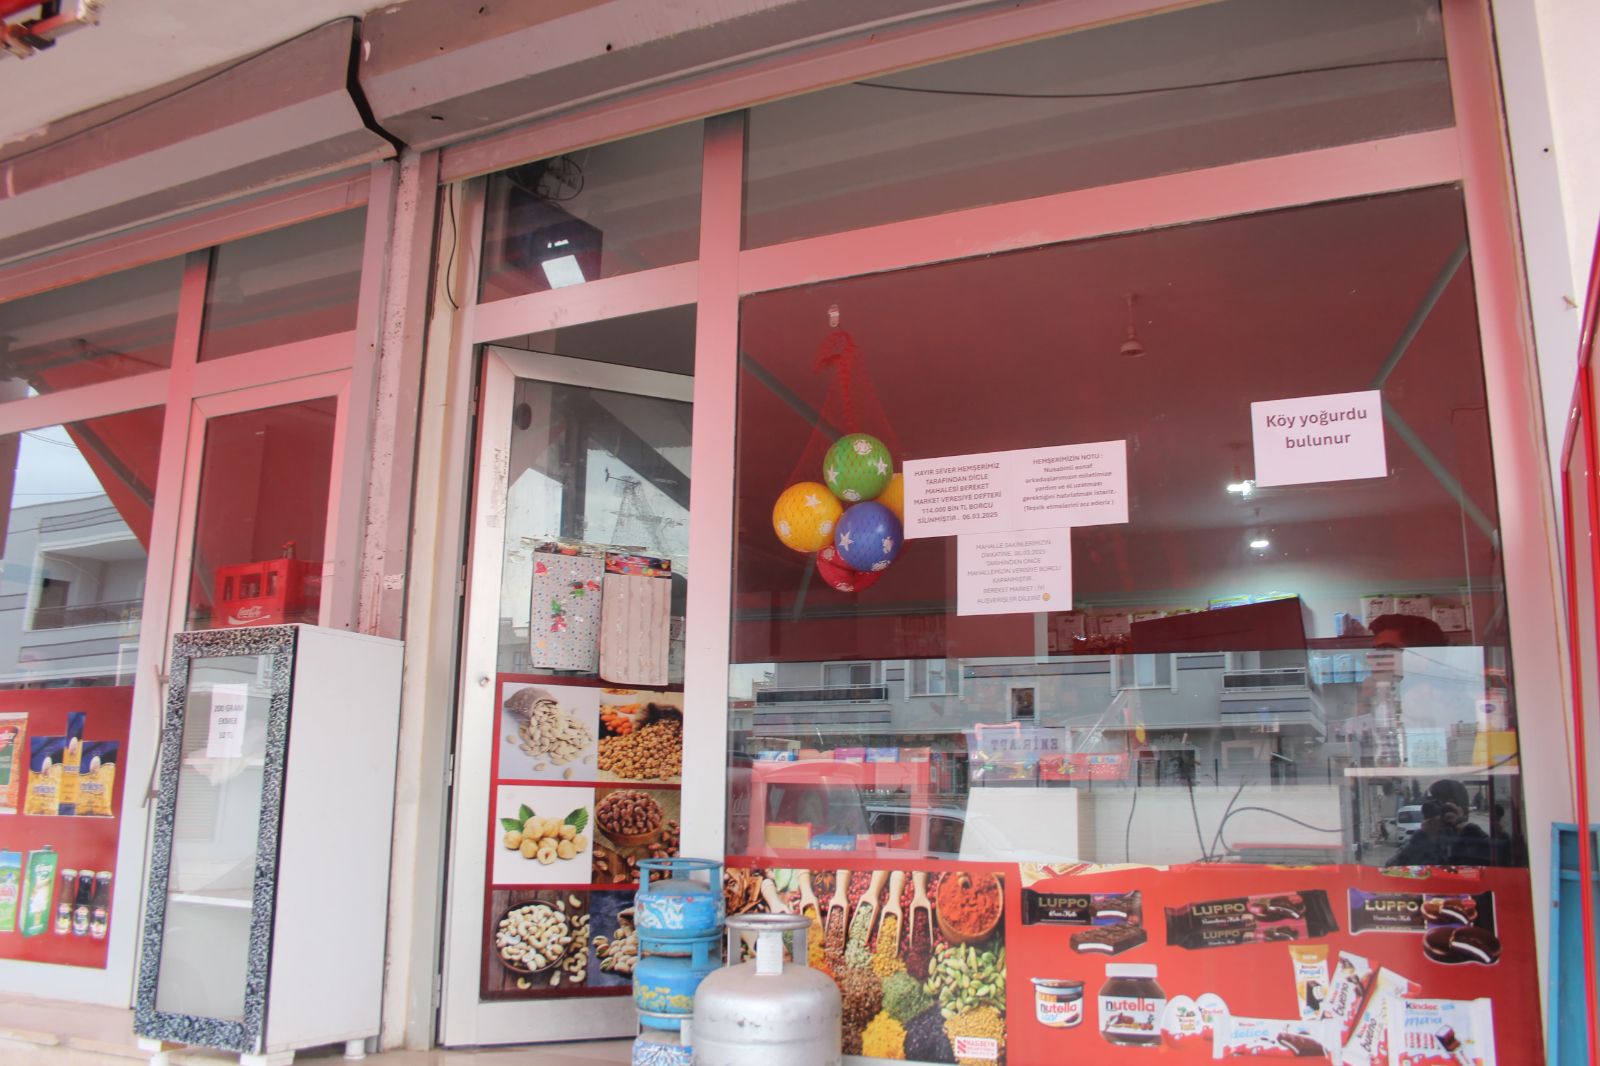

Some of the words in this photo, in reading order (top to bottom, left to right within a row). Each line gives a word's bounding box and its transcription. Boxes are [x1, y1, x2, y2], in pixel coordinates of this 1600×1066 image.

[1266, 414, 1296, 429] Köy
[1300, 408, 1367, 428] yoğurdu
[1286, 434, 1351, 448] bulunur
[914, 469, 935, 477] HAYIR
[936, 466, 957, 474] SEVER
[926, 476, 967, 485] TARAFINDAN
[960, 483, 990, 492] BEREKET
[962, 512, 998, 520] 06.03.2025
[1038, 896, 1088, 908] LUPPO
[1365, 899, 1419, 912] LUPPO
[1192, 903, 1245, 916] LUPPO
[1203, 930, 1240, 940] LUPPO
[1040, 1002, 1078, 1013] nutella
[1105, 997, 1155, 1012] nutella
[1360, 1018, 1377, 1053] bueno
